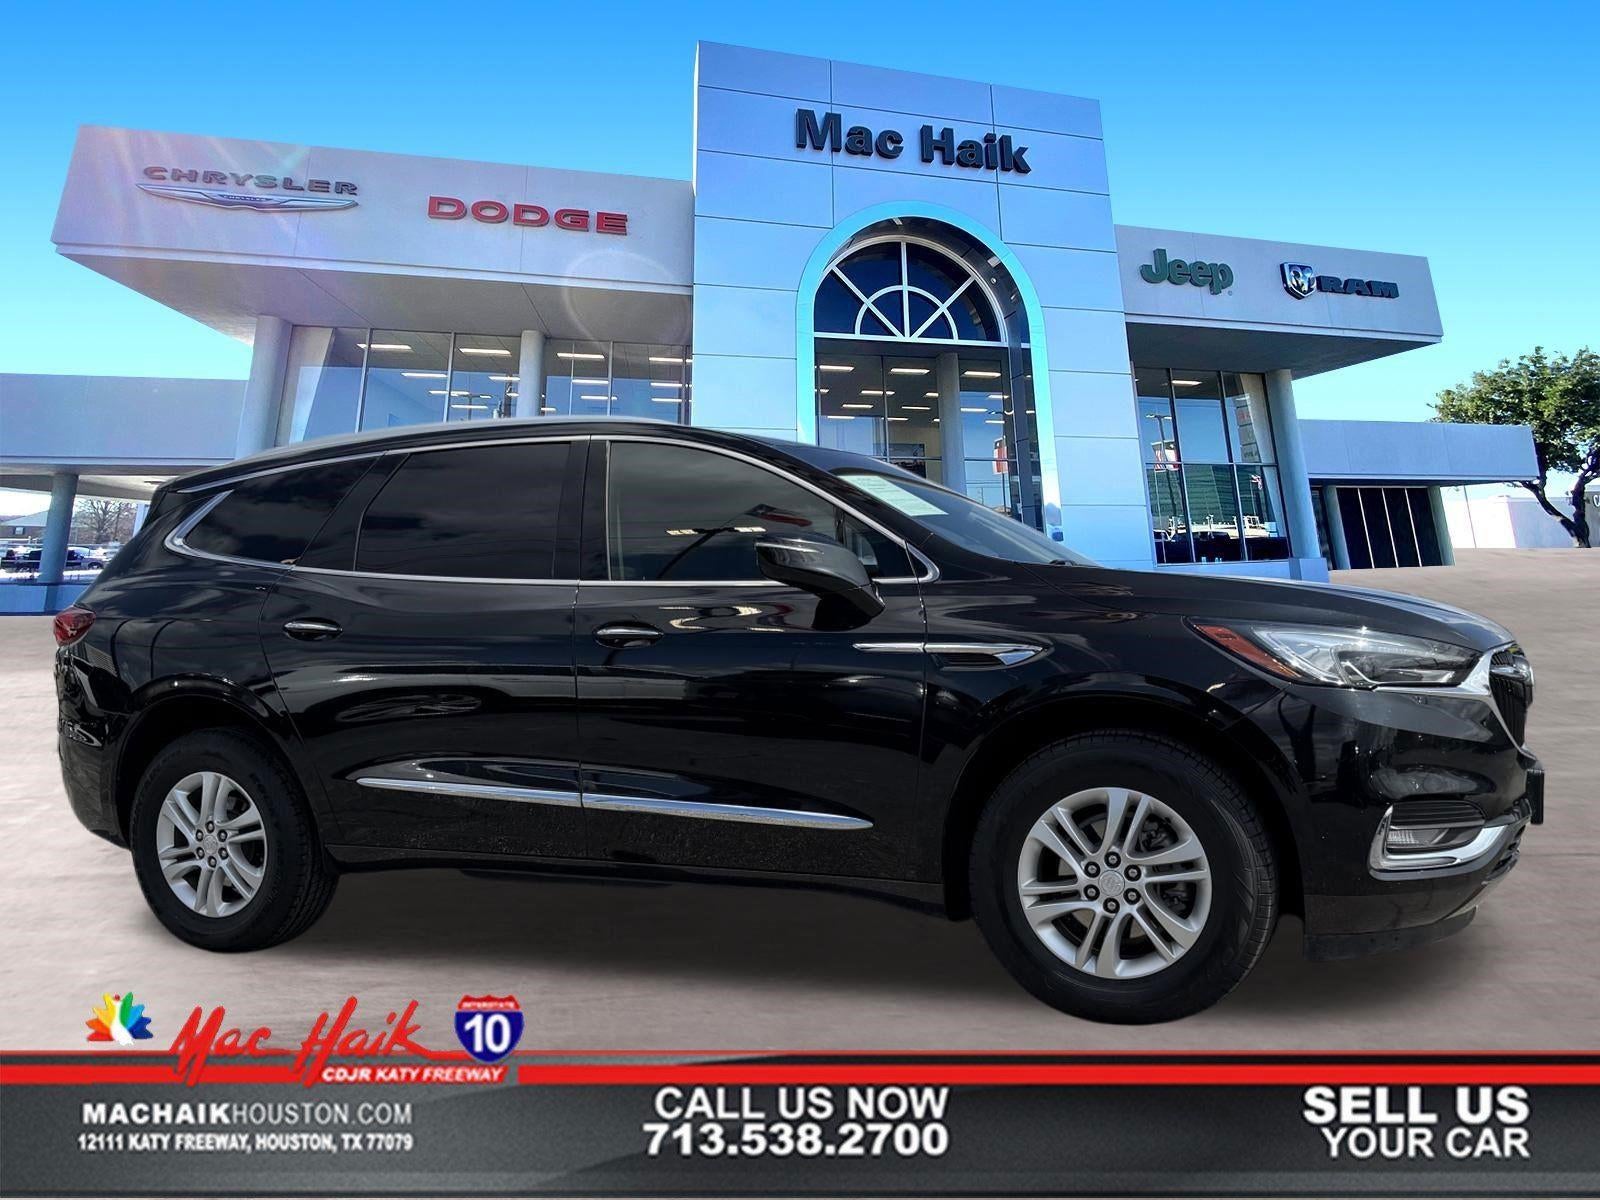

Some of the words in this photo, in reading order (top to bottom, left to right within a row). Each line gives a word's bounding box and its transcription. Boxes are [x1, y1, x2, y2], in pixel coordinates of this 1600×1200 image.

[796, 108, 904, 159] Mac
[920, 124, 1032, 174] Haik
[143, 166, 358, 196] CHRYSLER
[428, 196, 628, 236] DODGE
[1139, 248, 1234, 295] Jeep
[1316, 275, 1400, 299] RAM
